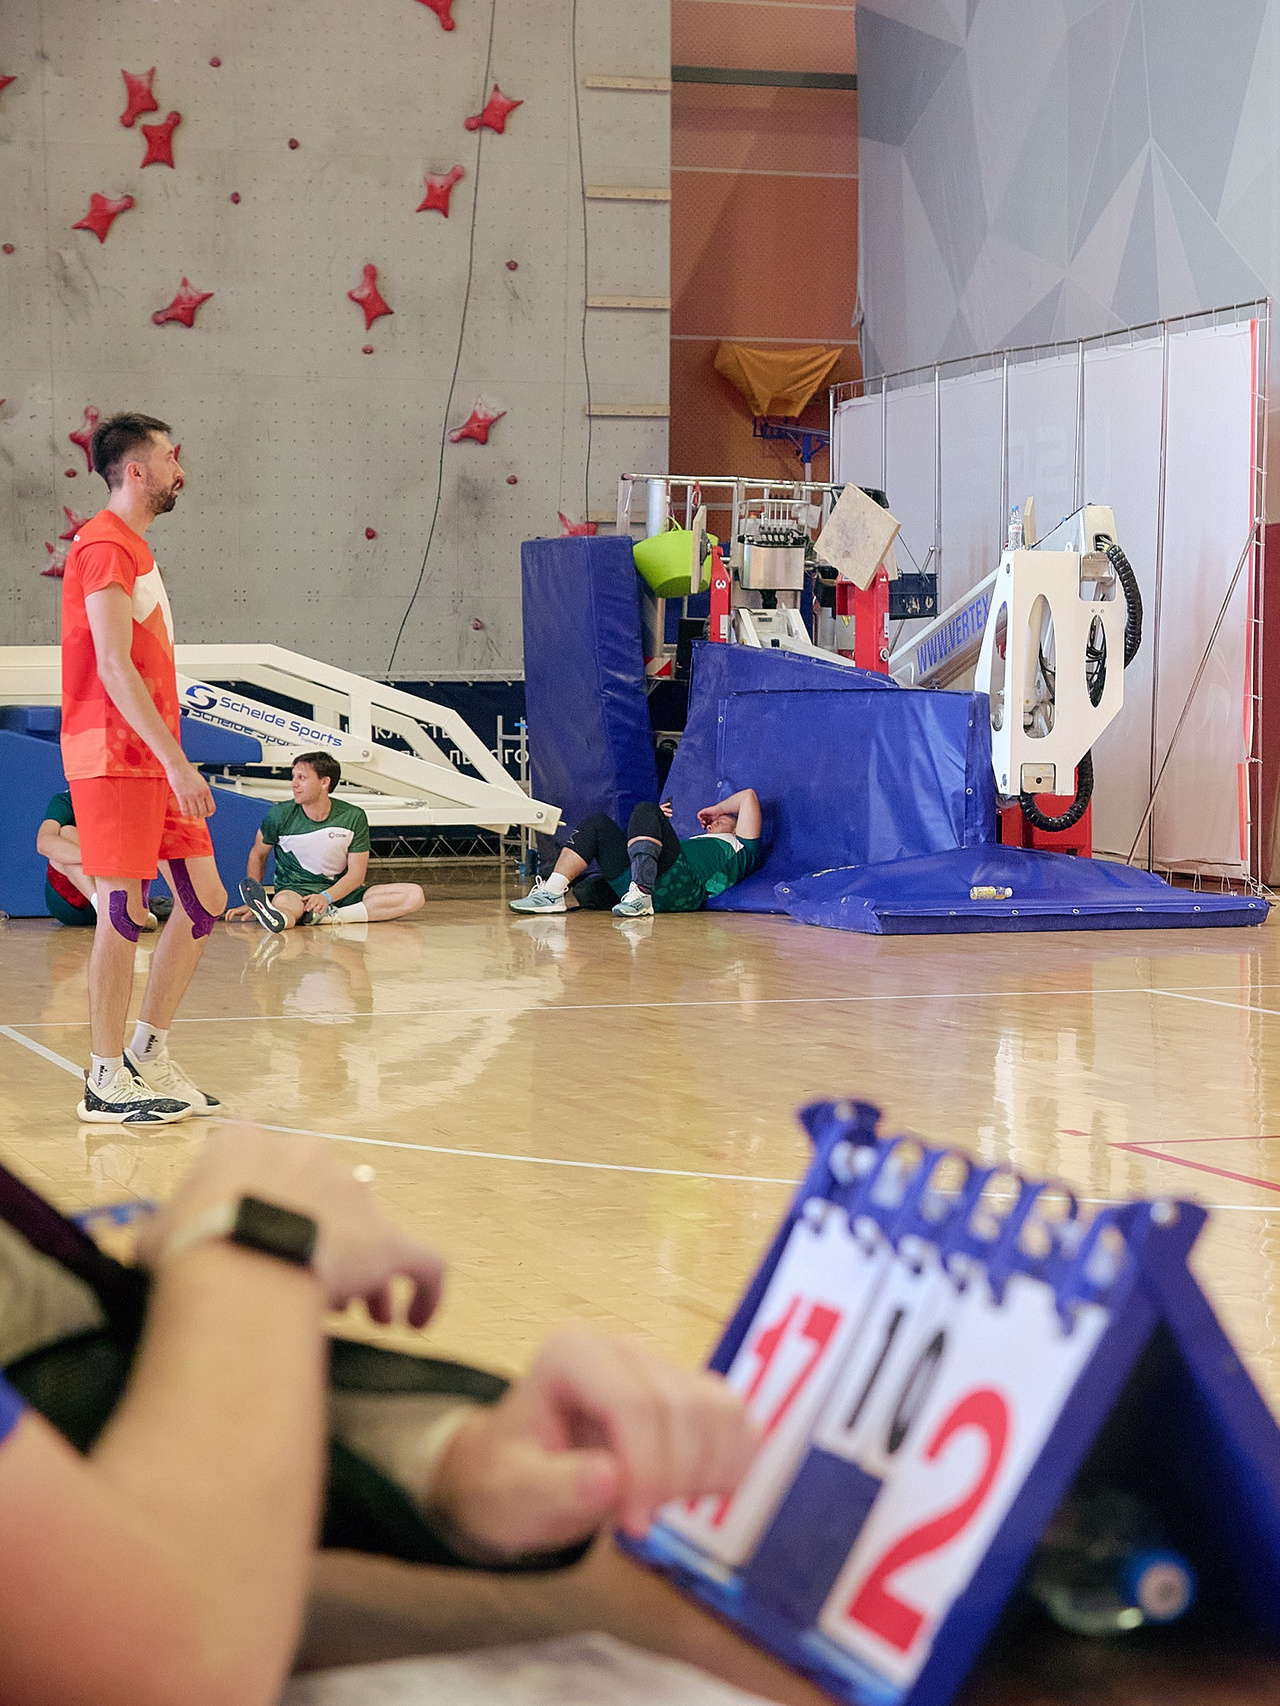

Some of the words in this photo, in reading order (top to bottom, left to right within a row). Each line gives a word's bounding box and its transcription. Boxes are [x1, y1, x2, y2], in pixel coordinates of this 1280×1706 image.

[219, 696, 286, 727] Schelde
[288, 720, 343, 747] Sports
[846, 1382, 1013, 1657] 2
